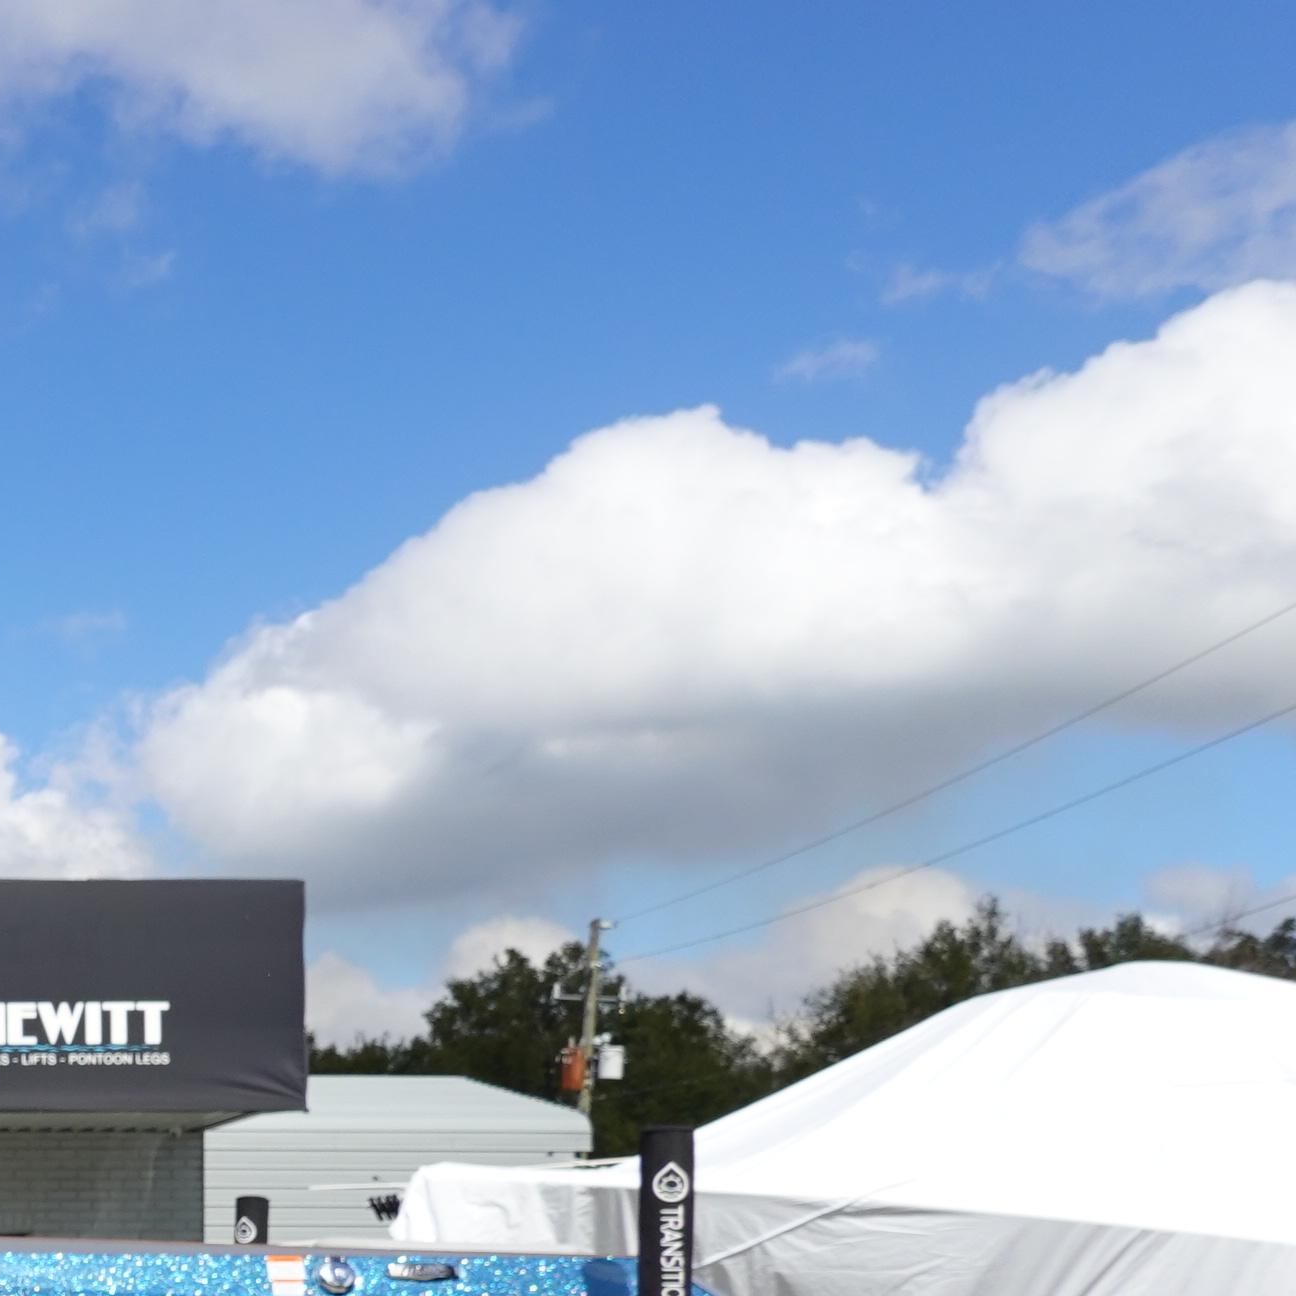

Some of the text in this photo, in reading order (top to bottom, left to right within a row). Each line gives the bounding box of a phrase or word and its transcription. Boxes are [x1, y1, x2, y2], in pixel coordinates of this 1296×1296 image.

[21, 1053, 57, 1065] LIFTS
[68, 1052, 134, 1065] PONTOON
[135, 1052, 171, 1065] LEGS
